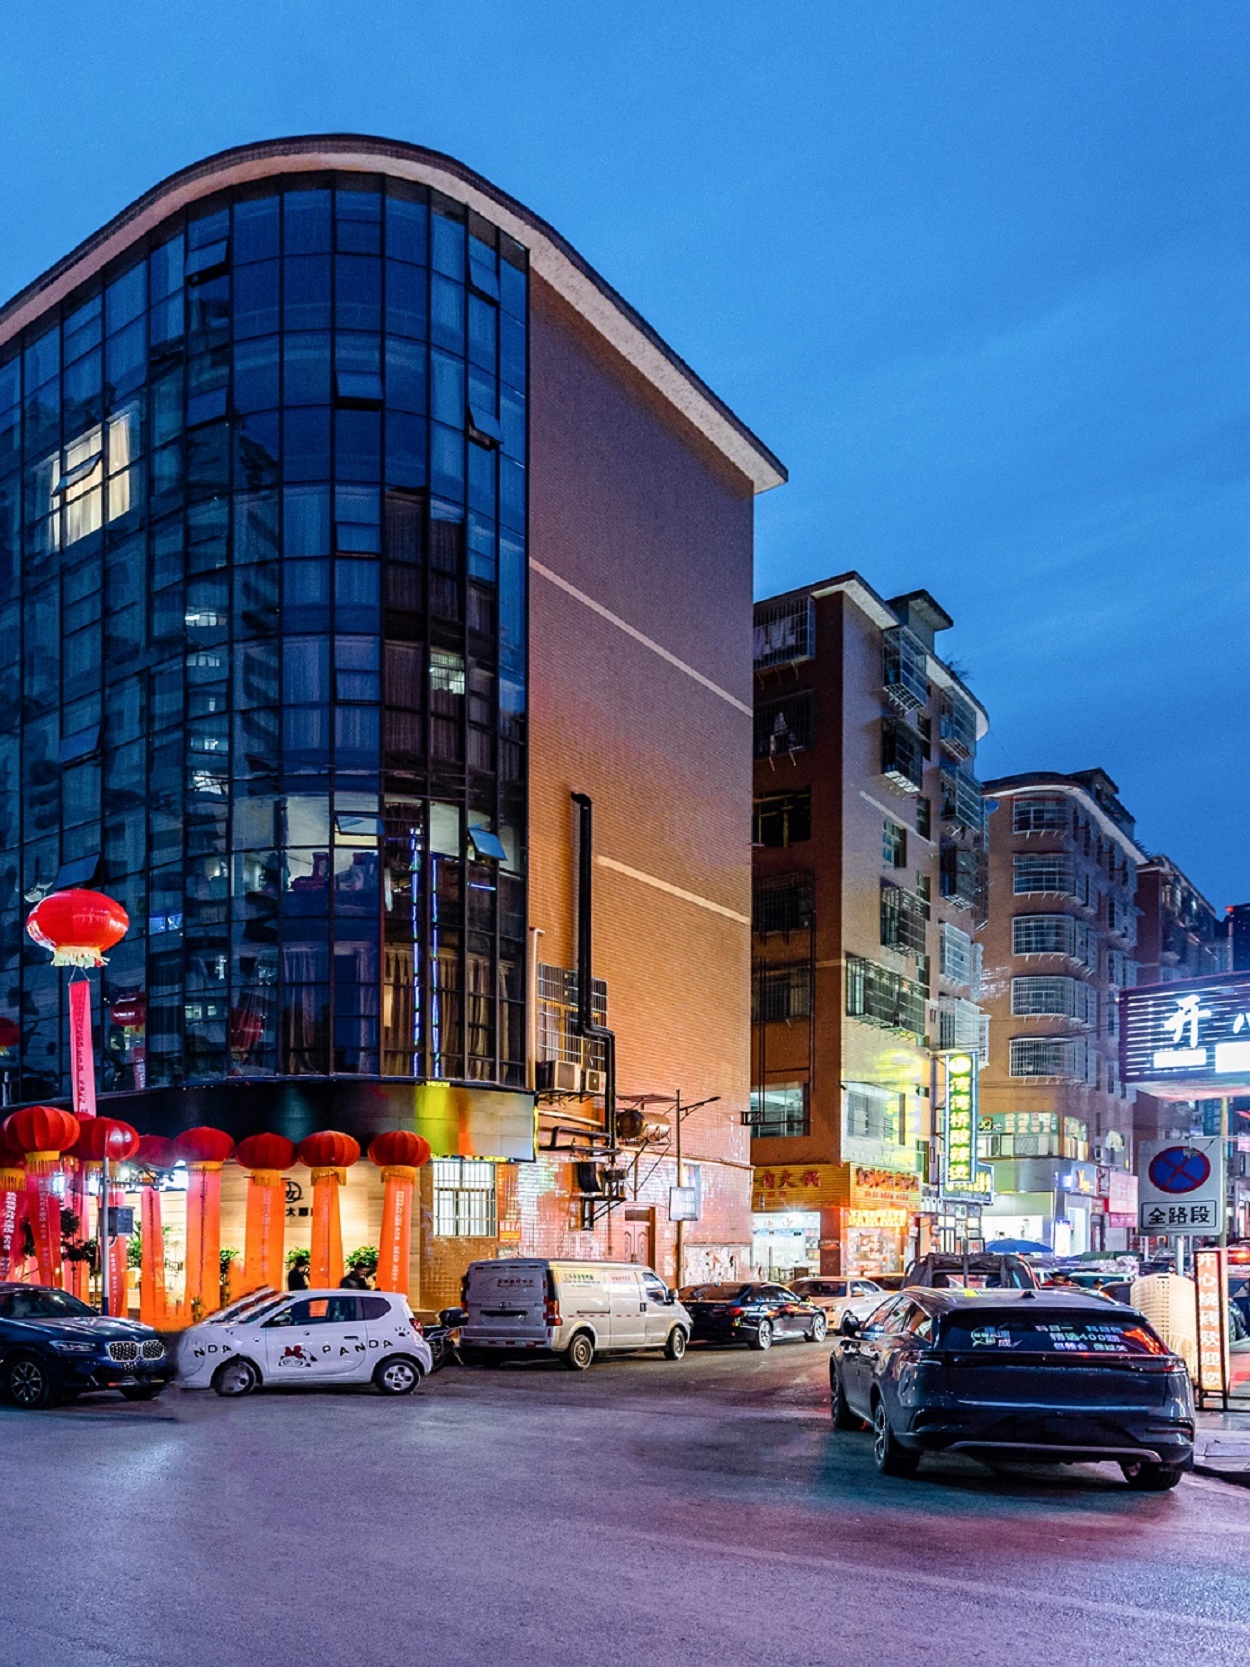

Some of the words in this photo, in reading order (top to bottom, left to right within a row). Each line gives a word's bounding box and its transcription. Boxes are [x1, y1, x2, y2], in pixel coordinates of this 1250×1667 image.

[1148, 1205, 1210, 1225] 全路段
[322, 1339, 393, 1357] PANDA
